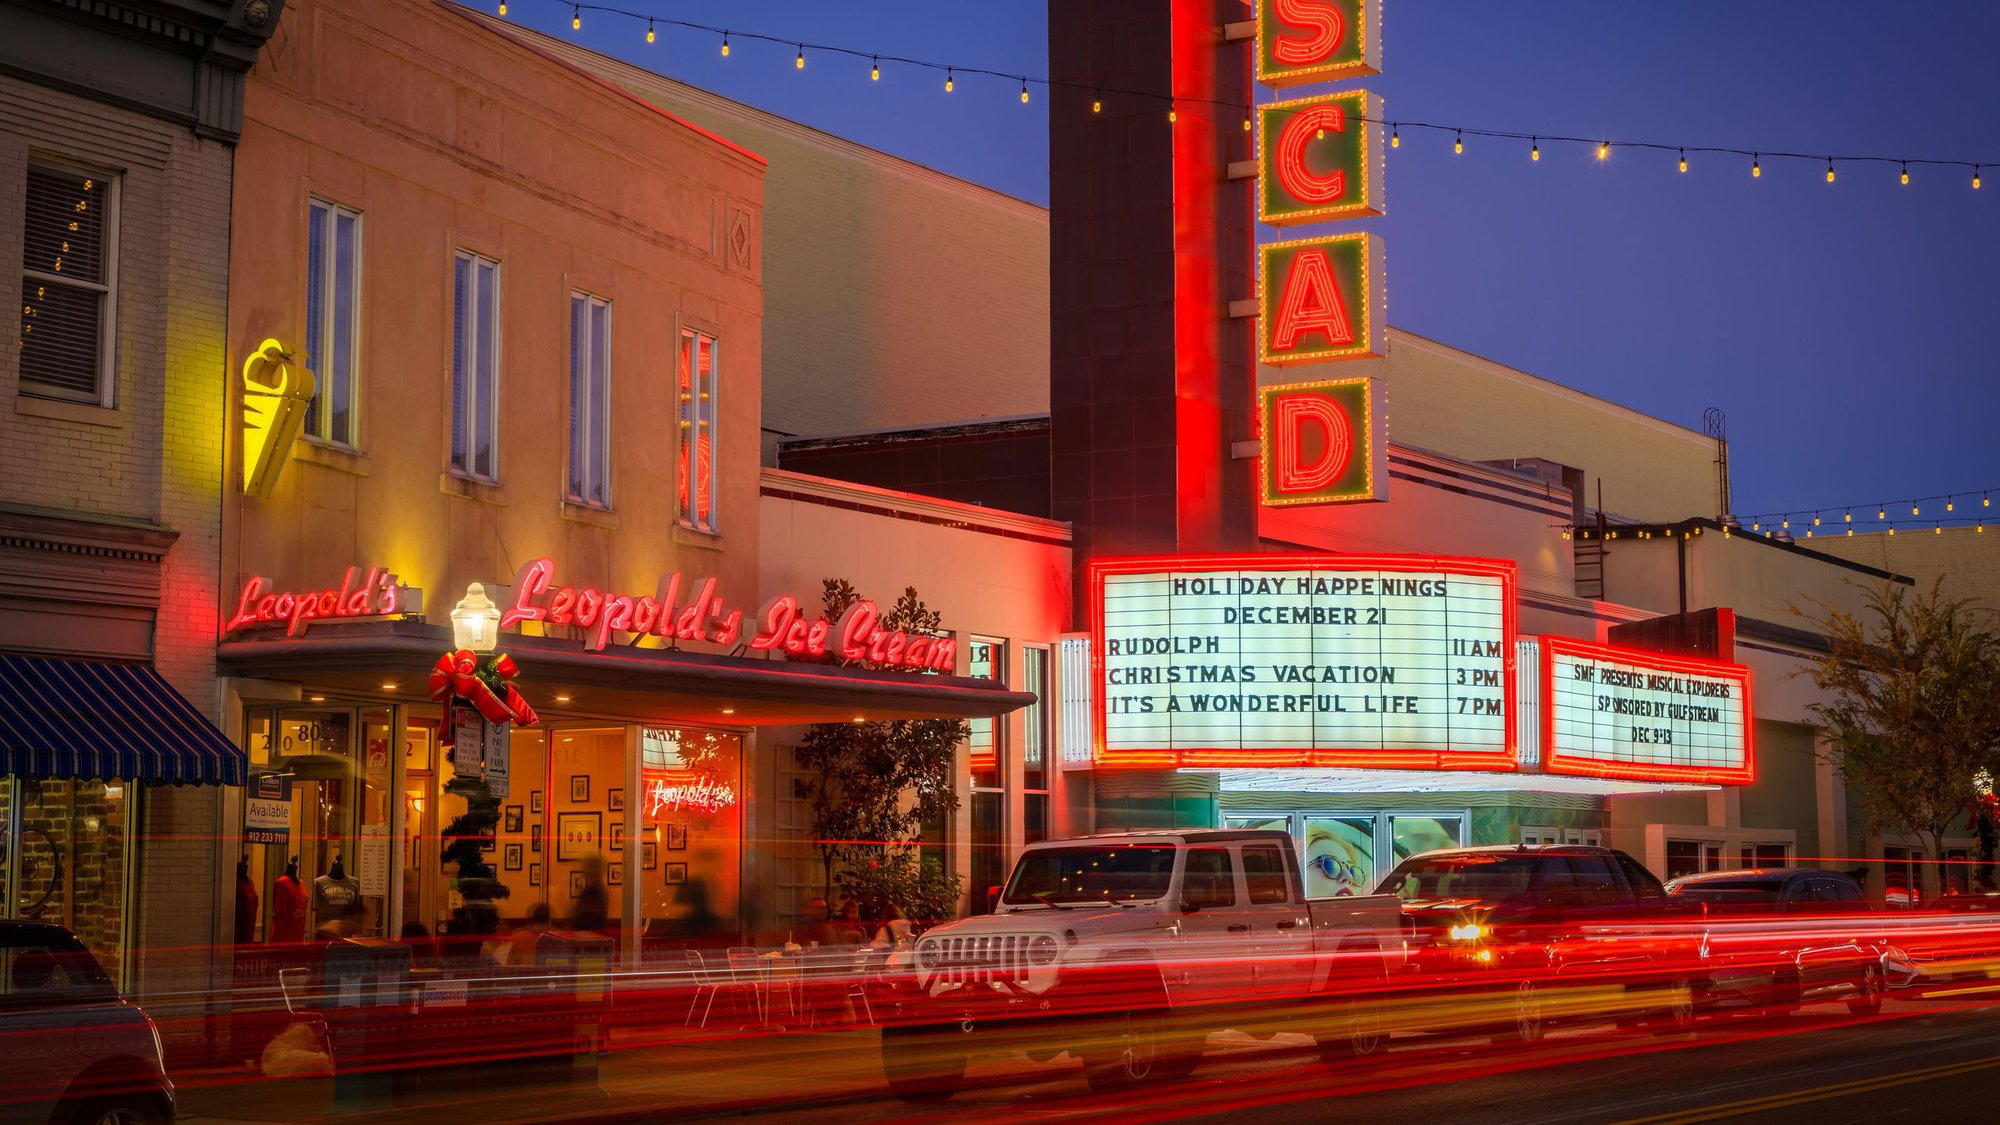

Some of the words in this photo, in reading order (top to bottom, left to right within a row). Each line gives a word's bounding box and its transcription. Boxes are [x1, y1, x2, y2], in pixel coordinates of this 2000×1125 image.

[1174, 577, 1286, 595] HOLIDAY
[1297, 577, 1448, 597] HAPPENINGS
[227, 565, 397, 636] Leopold's
[500, 557, 743, 651] Leopold's
[751, 593, 828, 657] Ice
[832, 598, 957, 672] Cream
[1224, 606, 1357, 625] DECEMBER
[1366, 607, 1387, 625] 21
[1108, 636, 1220, 656] RUDOLPH
[1108, 665, 1256, 685] CHRISTMAS
[1272, 665, 1396, 685] VACATION
[1456, 667, 1466, 686] 3
[1472, 668, 1499, 687] PM
[1600, 667, 1644, 689] PRESENTS
[1647, 673, 1683, 694] MUSICAL
[1686, 678, 1730, 698] EXPLORERS
[1112, 695, 1154, 714] IT'S
[1166, 694, 1182, 713] A
[1190, 694, 1347, 713] WONDERFUL
[1364, 695, 1419, 714] LIFE
[1457, 696, 1468, 715] 7
[1473, 697, 1501, 716] PM
[1654, 701, 1666, 718] BY
[1632, 726, 1650, 744] DEC
[249, 802, 289, 819] Available
[248, 831, 260, 842] 912
